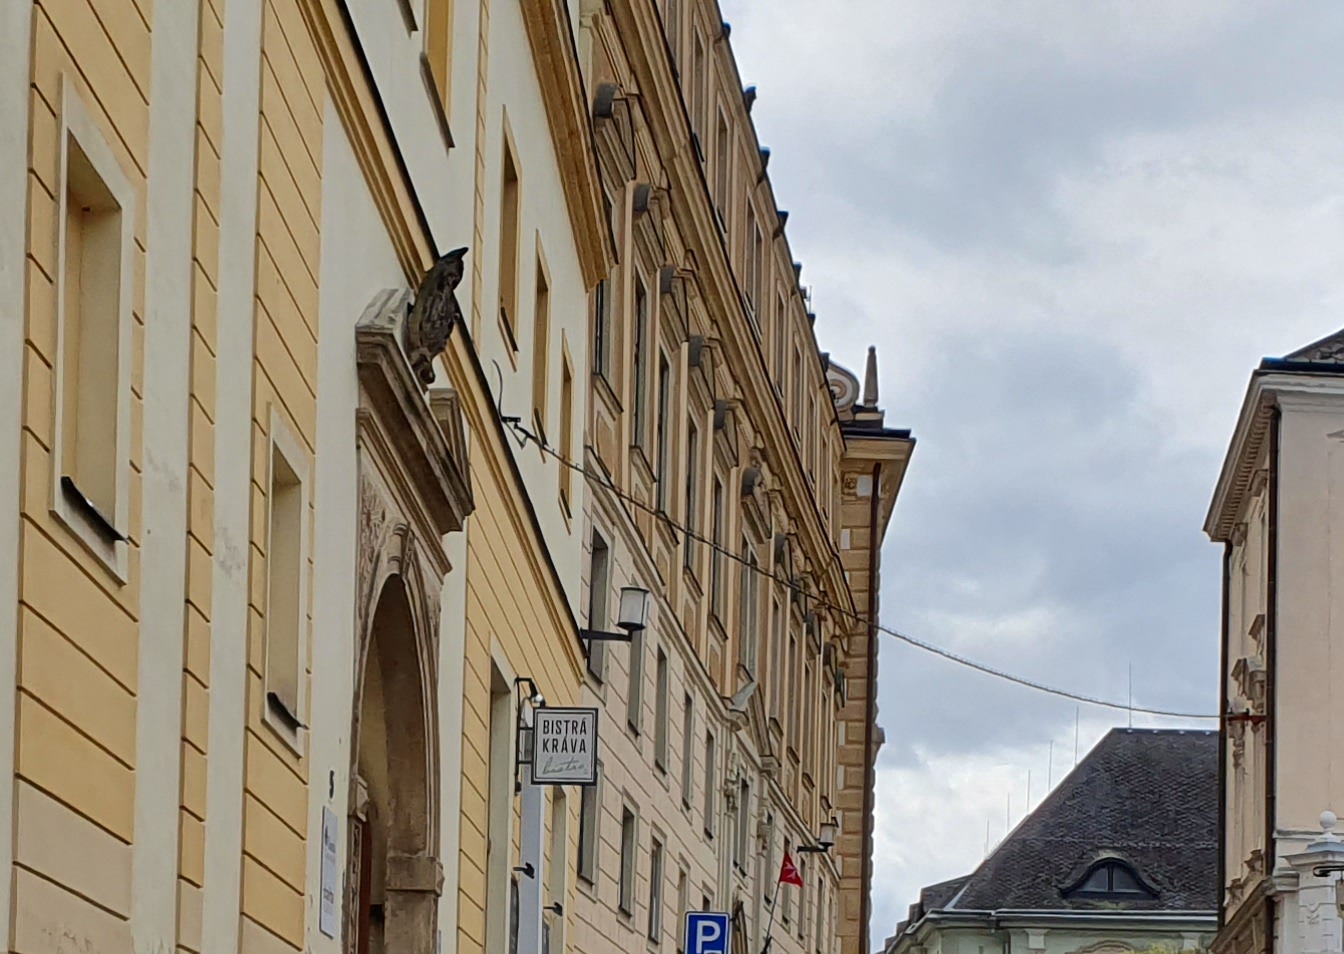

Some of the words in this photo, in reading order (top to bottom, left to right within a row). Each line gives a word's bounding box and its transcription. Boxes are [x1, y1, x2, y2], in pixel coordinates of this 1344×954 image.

[543, 717, 587, 735] BISTRÁ
[542, 736, 587, 754] KRÁVA
[696, 920, 721, 954] P
